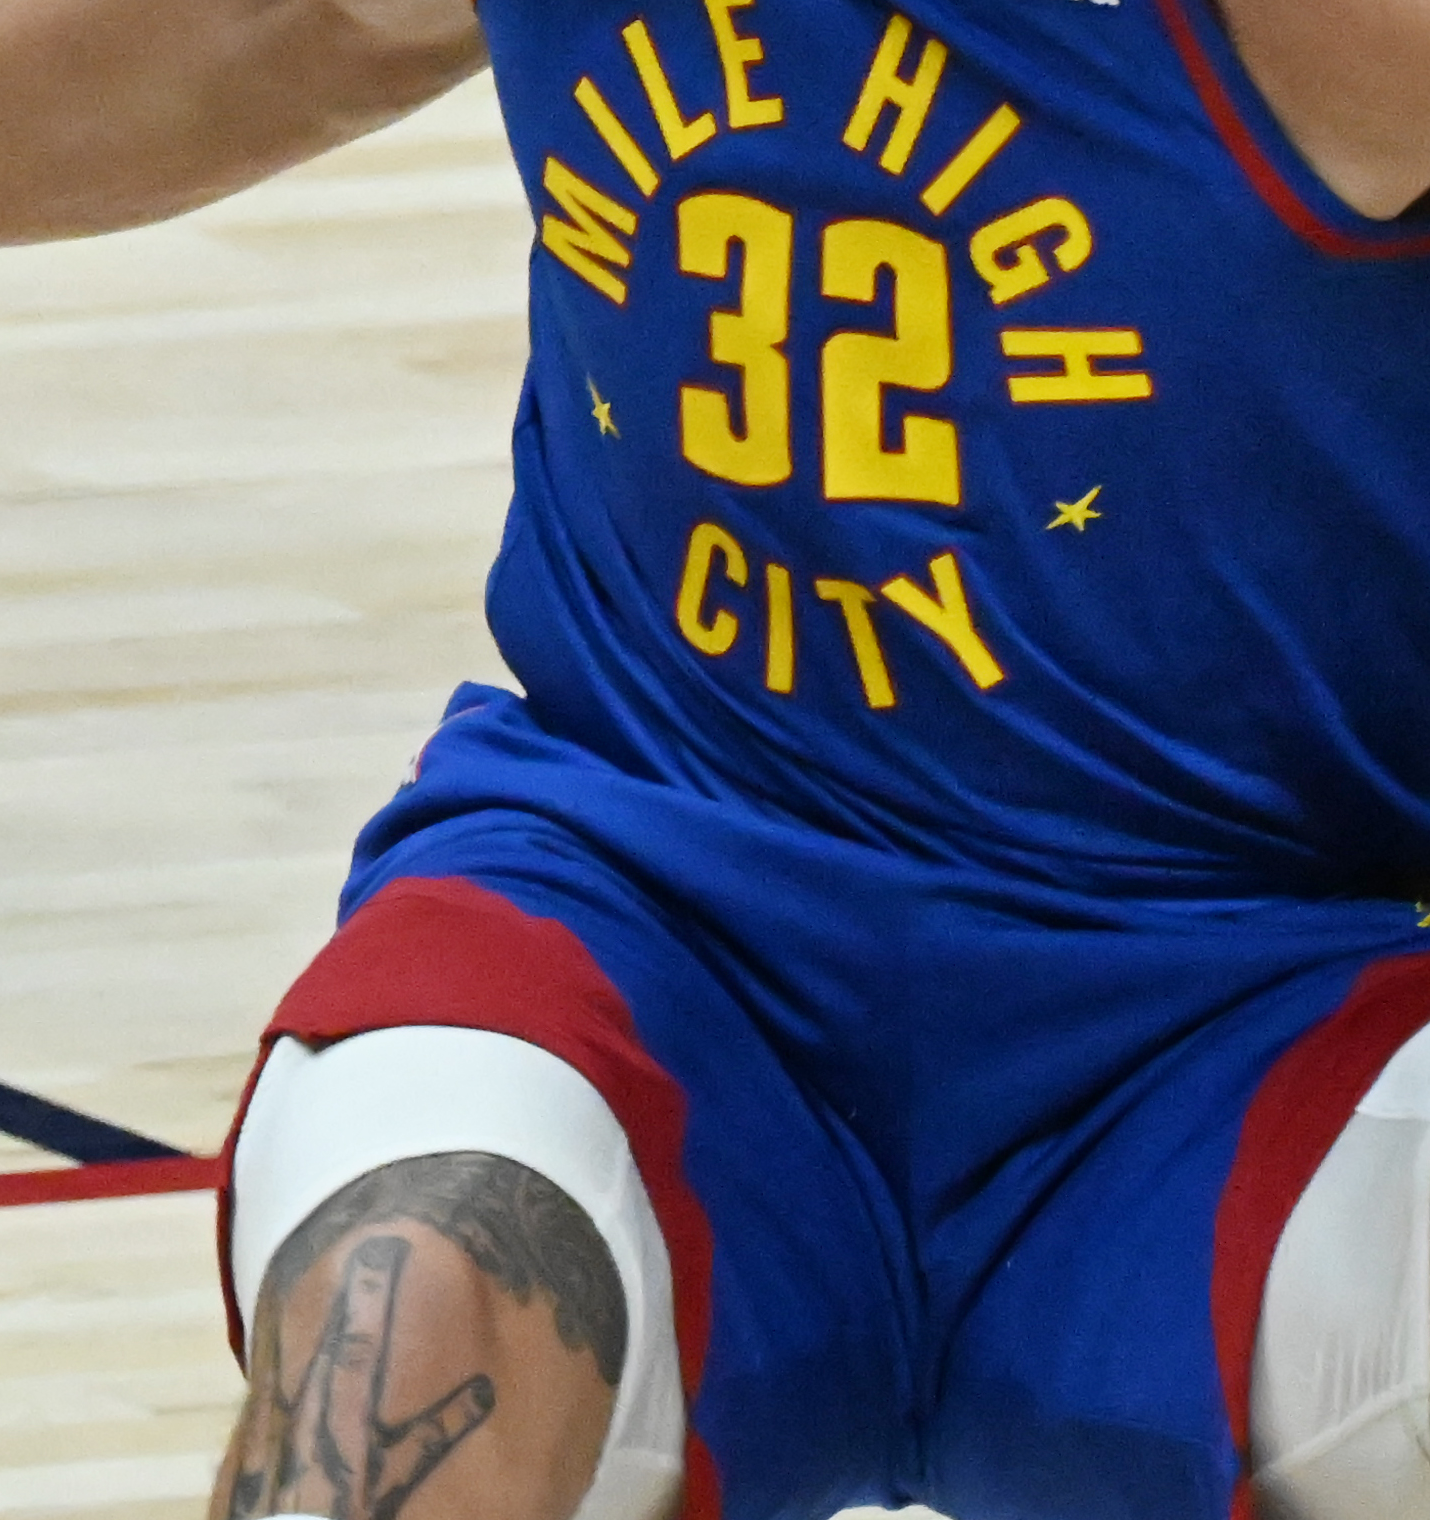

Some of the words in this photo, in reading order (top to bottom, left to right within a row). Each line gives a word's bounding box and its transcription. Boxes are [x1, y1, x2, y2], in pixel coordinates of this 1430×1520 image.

[675, 190, 961, 508] 32
[841, 13, 1154, 405] HIGH
[673, 520, 1007, 711] CITY
